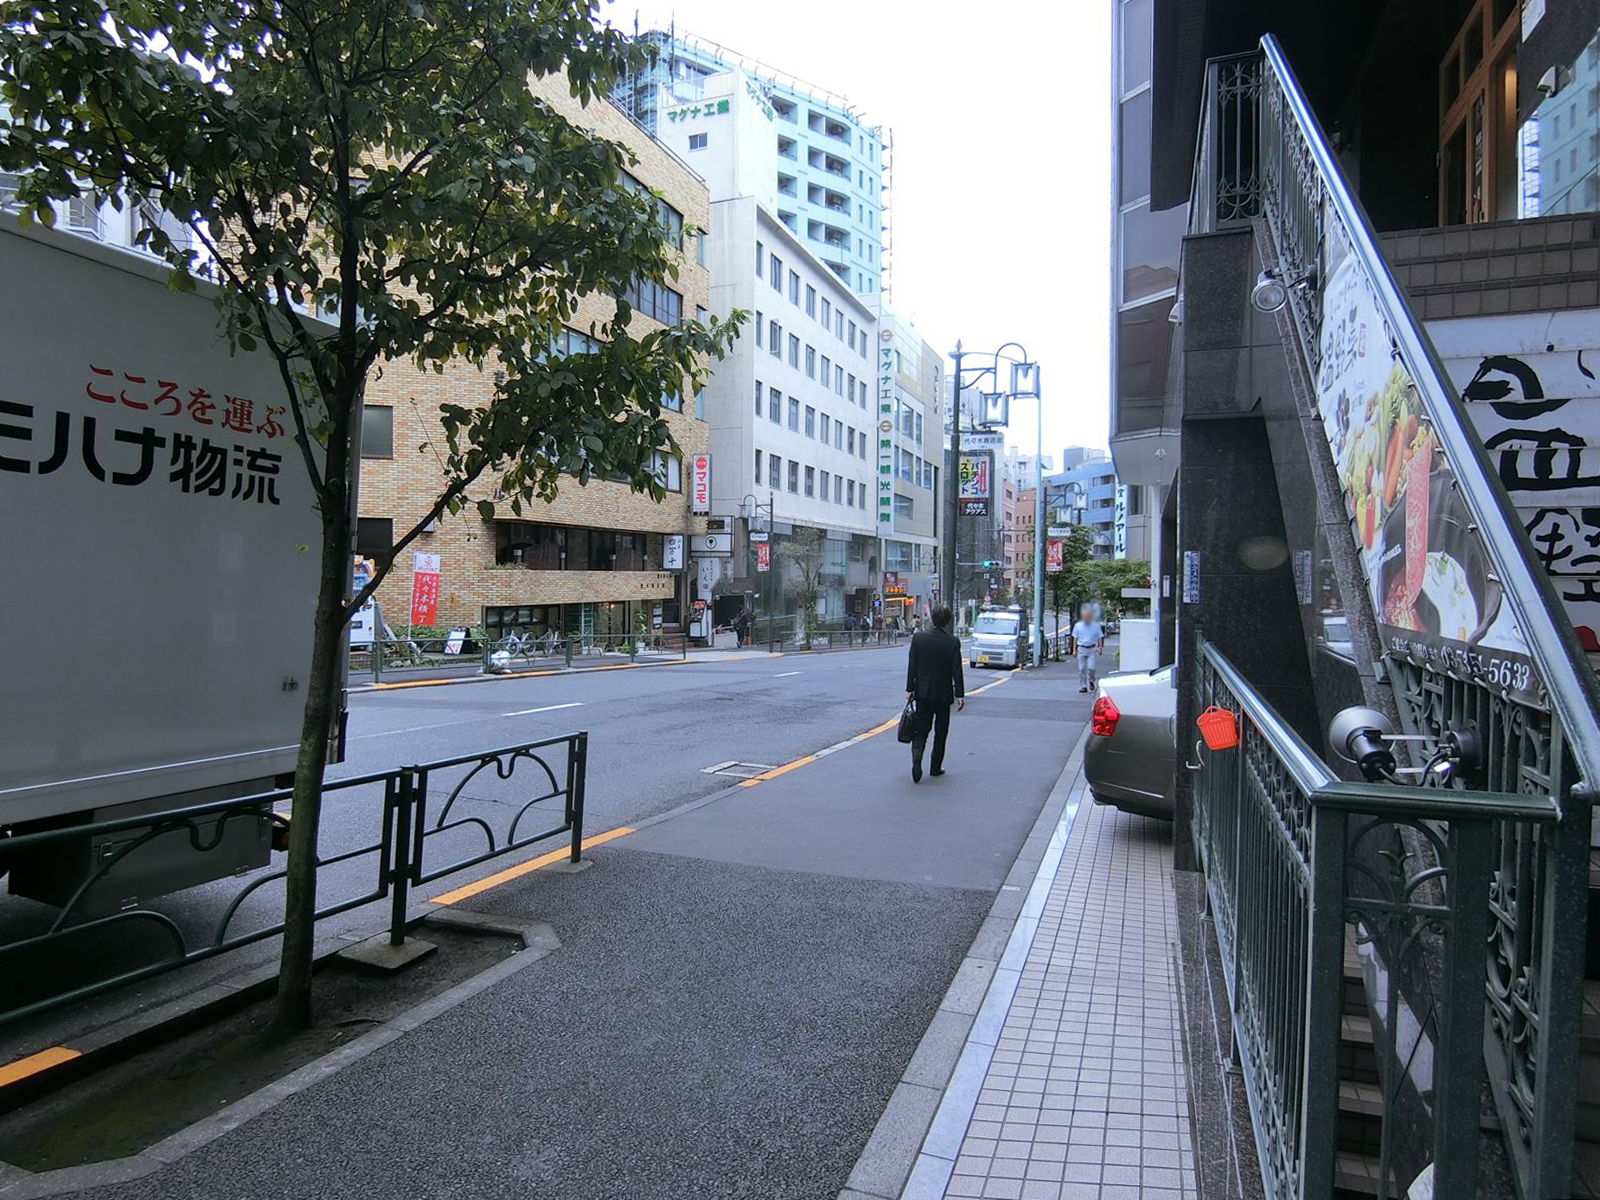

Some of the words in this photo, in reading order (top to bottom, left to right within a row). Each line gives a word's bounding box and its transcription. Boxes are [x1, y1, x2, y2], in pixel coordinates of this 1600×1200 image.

[667, 99, 730, 123] マグナ工業
[881, 347, 892, 414] マグナ工業
[86, 364, 286, 439] こころを運ぶ
[695, 471, 707, 504] マコモ
[961, 462, 970, 495] スロット
[971, 462, 980, 495] パチンコ
